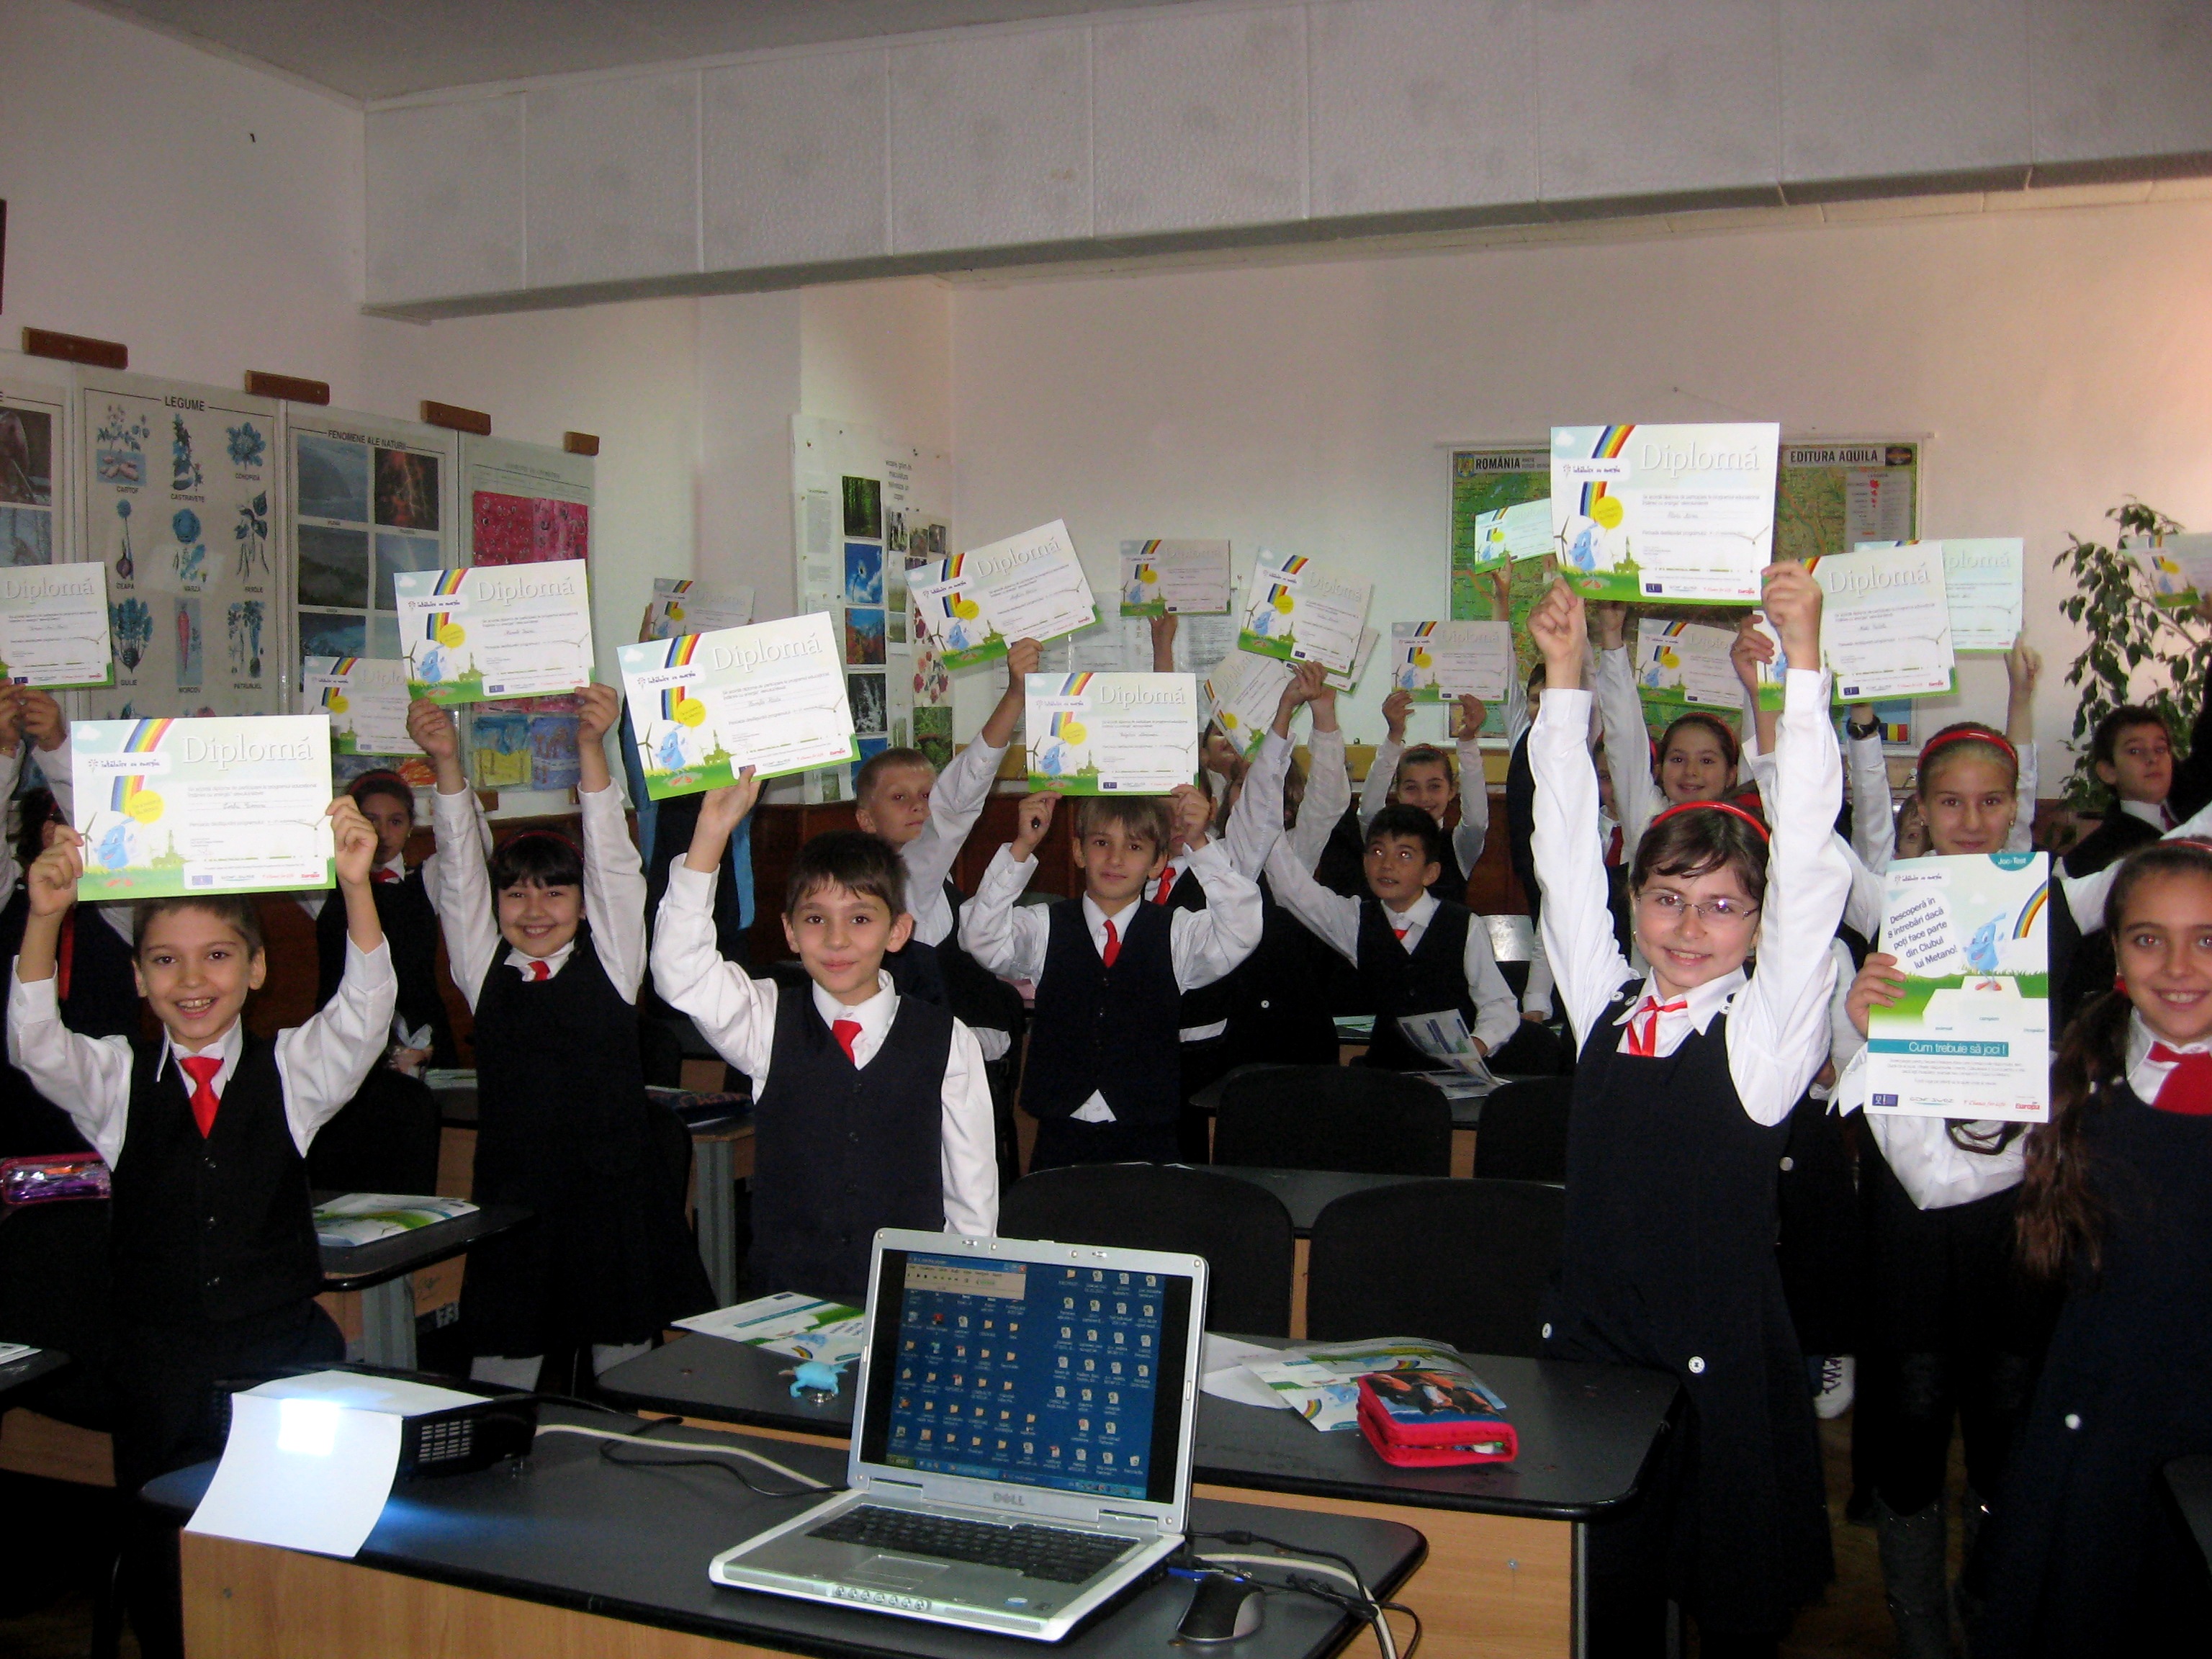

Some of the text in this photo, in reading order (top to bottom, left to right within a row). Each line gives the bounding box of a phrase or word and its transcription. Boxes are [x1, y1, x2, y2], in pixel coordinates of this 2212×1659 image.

[165, 396, 204, 411] LEGUME
[328, 430, 365, 444] FENOMENE
[367, 436, 380, 446] ALE
[1790, 449, 1878, 463] EDITURA AQUILA
[171, 493, 204, 503] CASTRAVETE
[1927, 897, 1936, 906] în
[1925, 906, 1945, 921] dacă
[1908, 930, 1925, 943] face
[1926, 921, 1948, 936] parte
[1906, 948, 1919, 958] din
[1913, 945, 1958, 969] lui Metano!
[1909, 1041, 2005, 1056] Cum trebuie să joci !
[992, 1492, 1025, 1506] DELL
